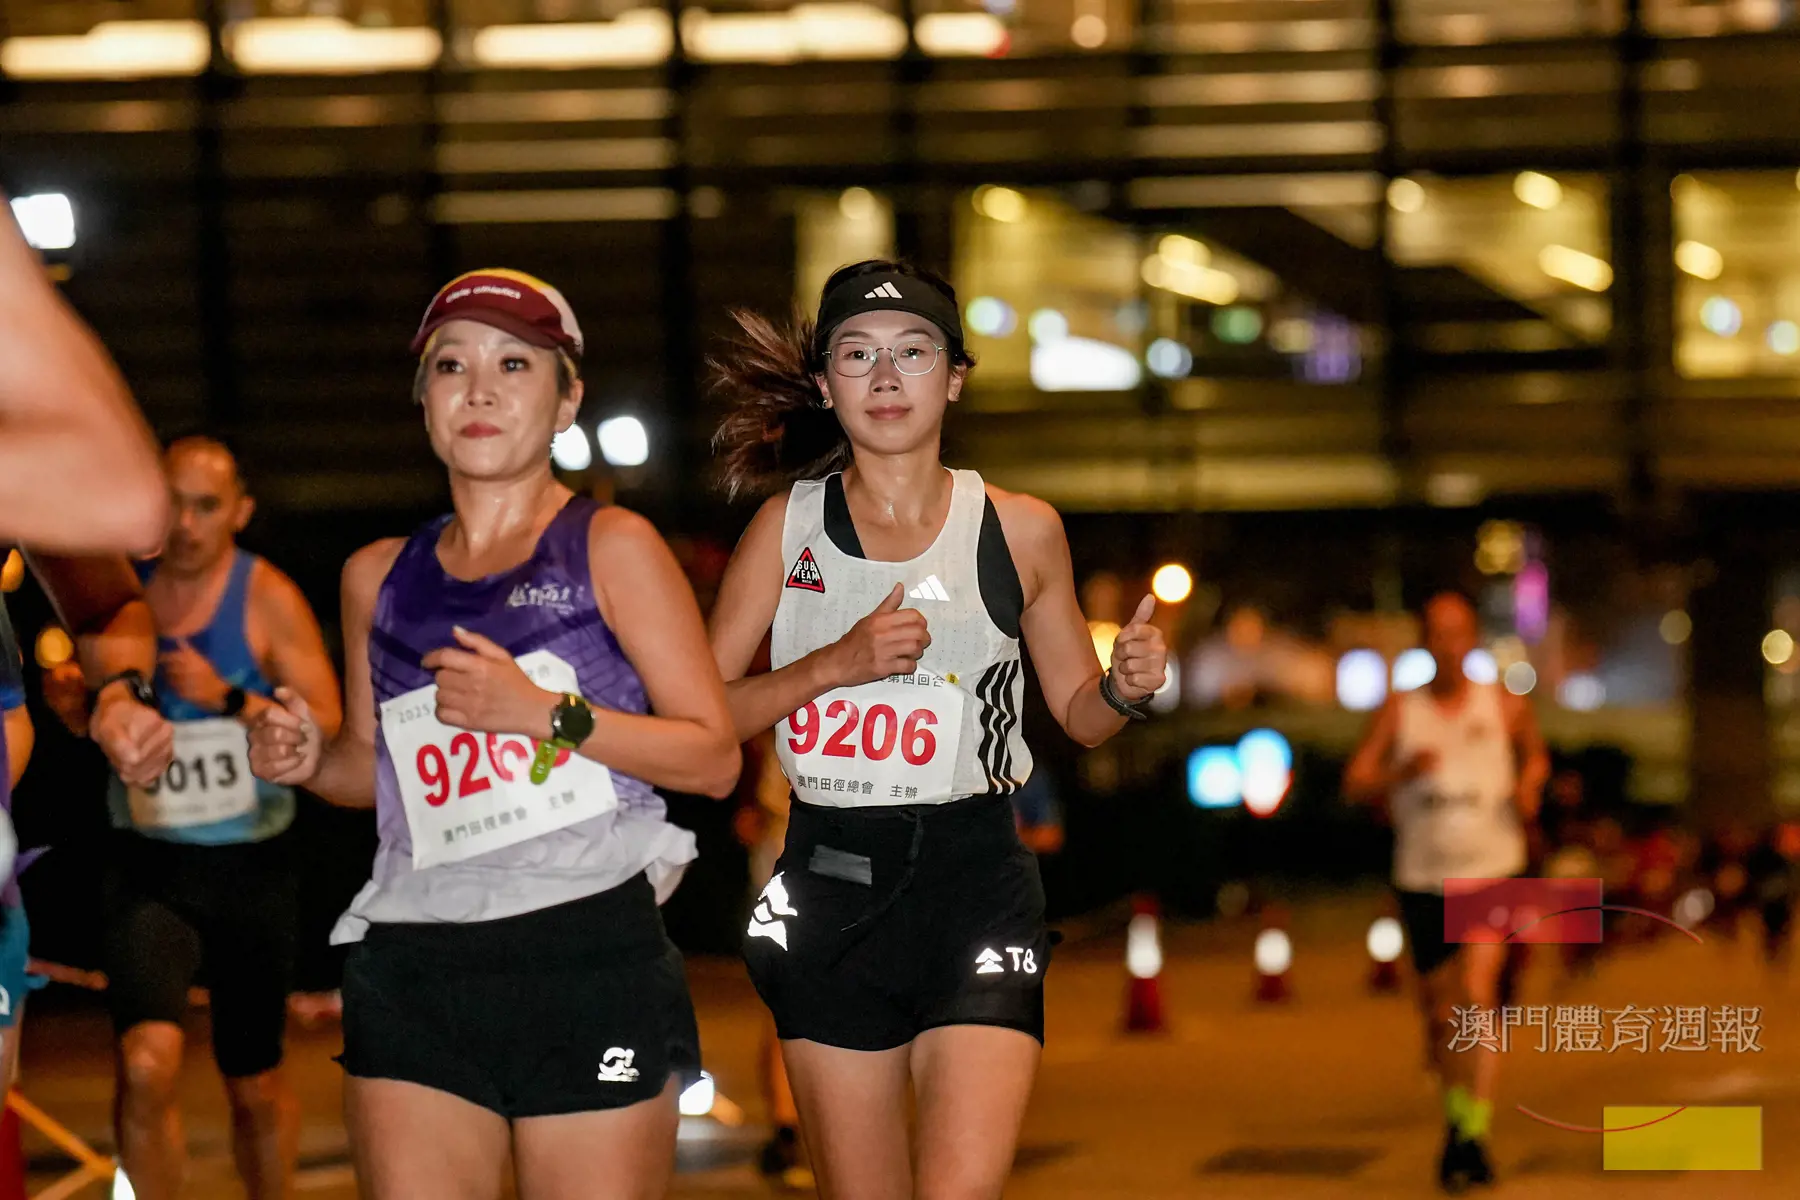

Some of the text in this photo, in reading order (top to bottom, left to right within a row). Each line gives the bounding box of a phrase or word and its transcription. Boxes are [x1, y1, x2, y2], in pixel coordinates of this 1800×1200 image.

[796, 570, 818, 581] TEAM
[797, 560, 815, 571] SUB
[788, 700, 938, 766] 9206
[796, 775, 918, 799] 澳門田徑總會 主辦
[1005, 946, 1038, 974] T8
